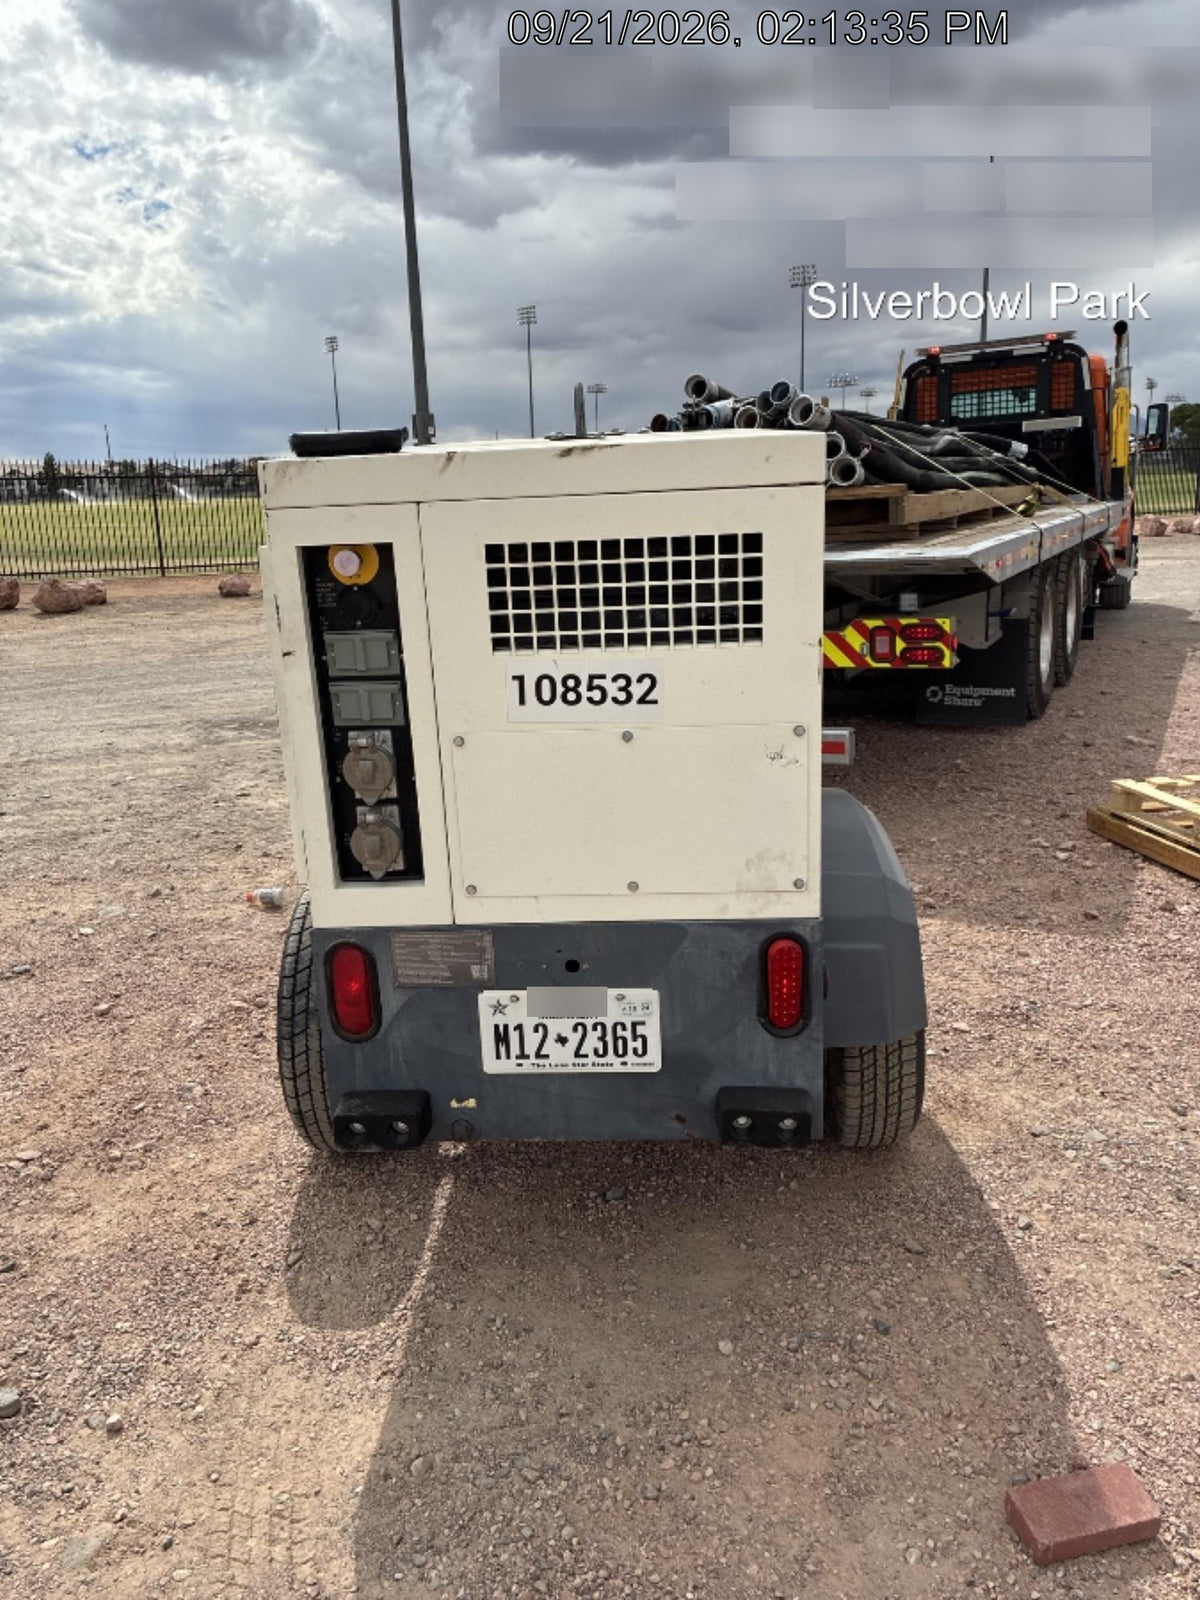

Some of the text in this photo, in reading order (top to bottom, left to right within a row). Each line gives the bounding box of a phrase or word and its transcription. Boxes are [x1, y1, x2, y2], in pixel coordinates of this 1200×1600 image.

[511, 673, 659, 706] 108532
[945, 684, 1015, 697] Equipment
[572, 1021, 648, 1058] 2365
